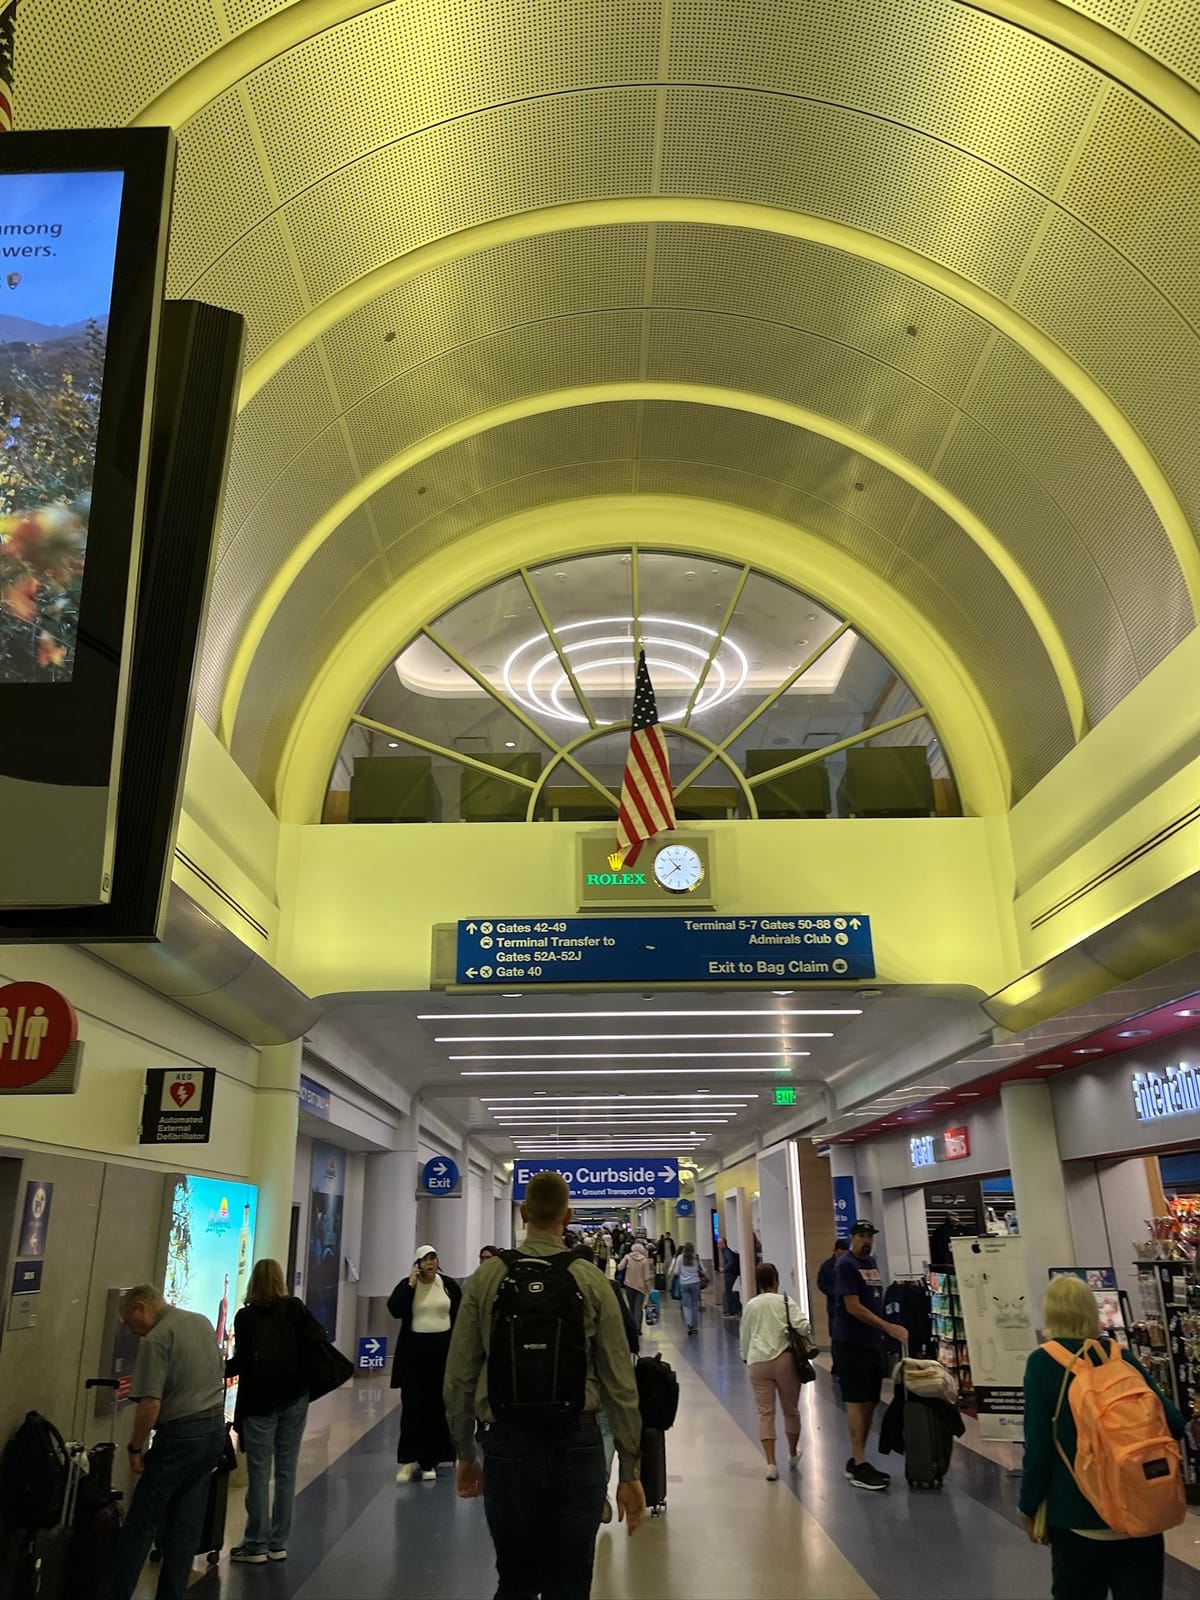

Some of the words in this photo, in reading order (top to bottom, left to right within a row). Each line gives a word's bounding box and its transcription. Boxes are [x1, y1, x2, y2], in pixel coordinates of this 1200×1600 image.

[0, 224, 62, 238] mong
[586, 873, 647, 885] ROLEX
[496, 923, 531, 933] Gates
[534, 922, 567, 933] 42-49
[684, 920, 736, 930] Terminal
[738, 920, 758, 930] 5-7
[760, 919, 795, 930] Gates
[798, 919, 831, 930] 50-88
[496, 937, 548, 948] Terminal
[550, 936, 600, 947] Transfer
[602, 936, 616, 946] to
[749, 934, 801, 945] Admirals
[803, 933, 832, 944] Club
[496, 952, 531, 962] Gates
[533, 951, 582, 962] 52A-52J
[496, 967, 525, 977] Gate
[527, 966, 542, 977] 40
[708, 961, 736, 973] Exit
[738, 961, 753, 973] to
[757, 961, 785, 976] Bag
[788, 960, 829, 973] Claim
[159, 1116, 203, 1124] Automated
[156, 1133, 205, 1141] Defibrillator
[576, 1167, 655, 1184] Curbside
[428, 1177, 451, 1188] Exit
[582, 1188, 606, 1196] Ground
[607, 1188, 637, 1196] Transport
[360, 1355, 384, 1367] Exit
